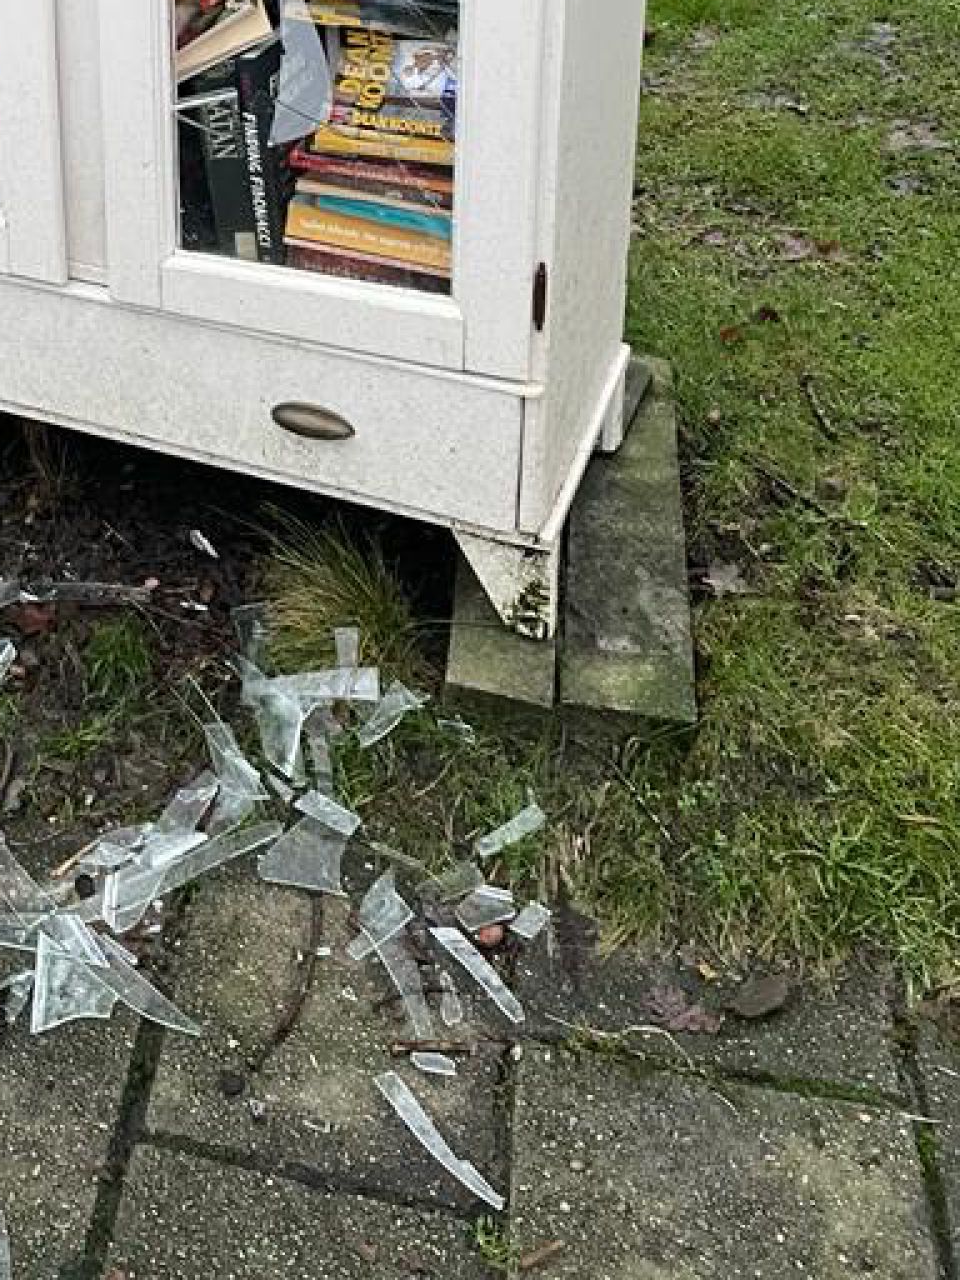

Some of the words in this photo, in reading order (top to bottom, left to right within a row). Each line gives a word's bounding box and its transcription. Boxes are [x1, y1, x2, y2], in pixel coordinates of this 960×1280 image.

[340, 29, 368, 94] DEAN
[241, 111, 264, 172] FINDING
[248, 174, 272, 248] FIBONACCI
